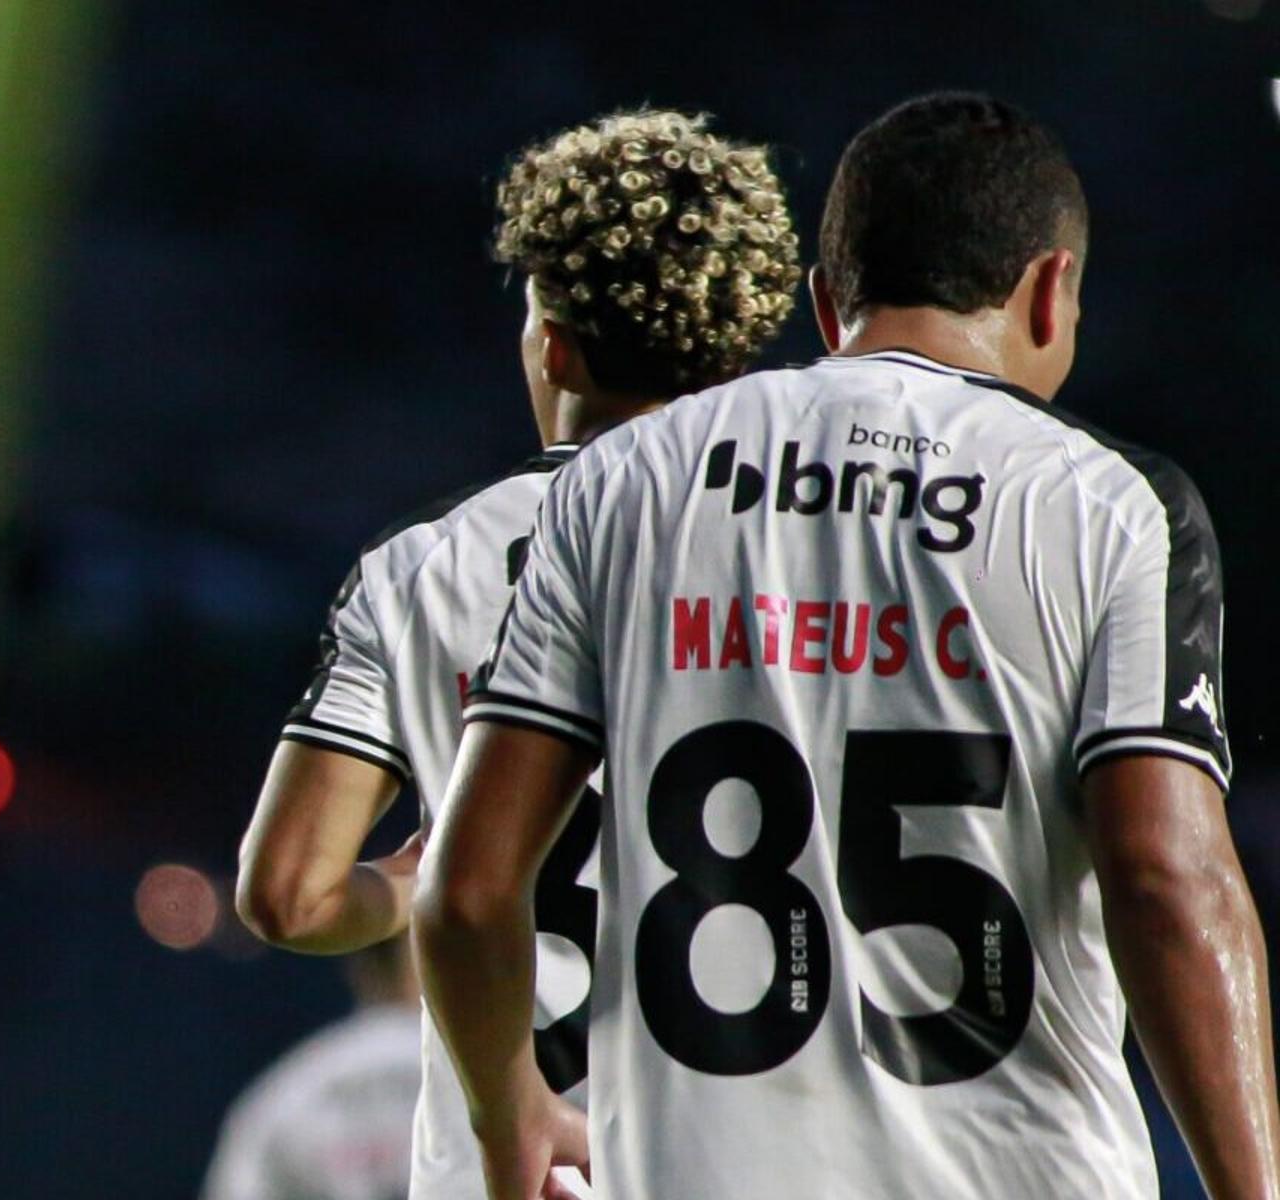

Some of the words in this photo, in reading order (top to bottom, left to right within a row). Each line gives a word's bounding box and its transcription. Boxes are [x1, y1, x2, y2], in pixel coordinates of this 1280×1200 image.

[847, 423, 951, 458] banco
[775, 440, 987, 553] bmg
[672, 595, 909, 677] MATEUS
[936, 606, 988, 681] C.
[634, 718, 1037, 1088] 85
[792, 907, 808, 976] SCORE
[982, 919, 1002, 987] SCORE
